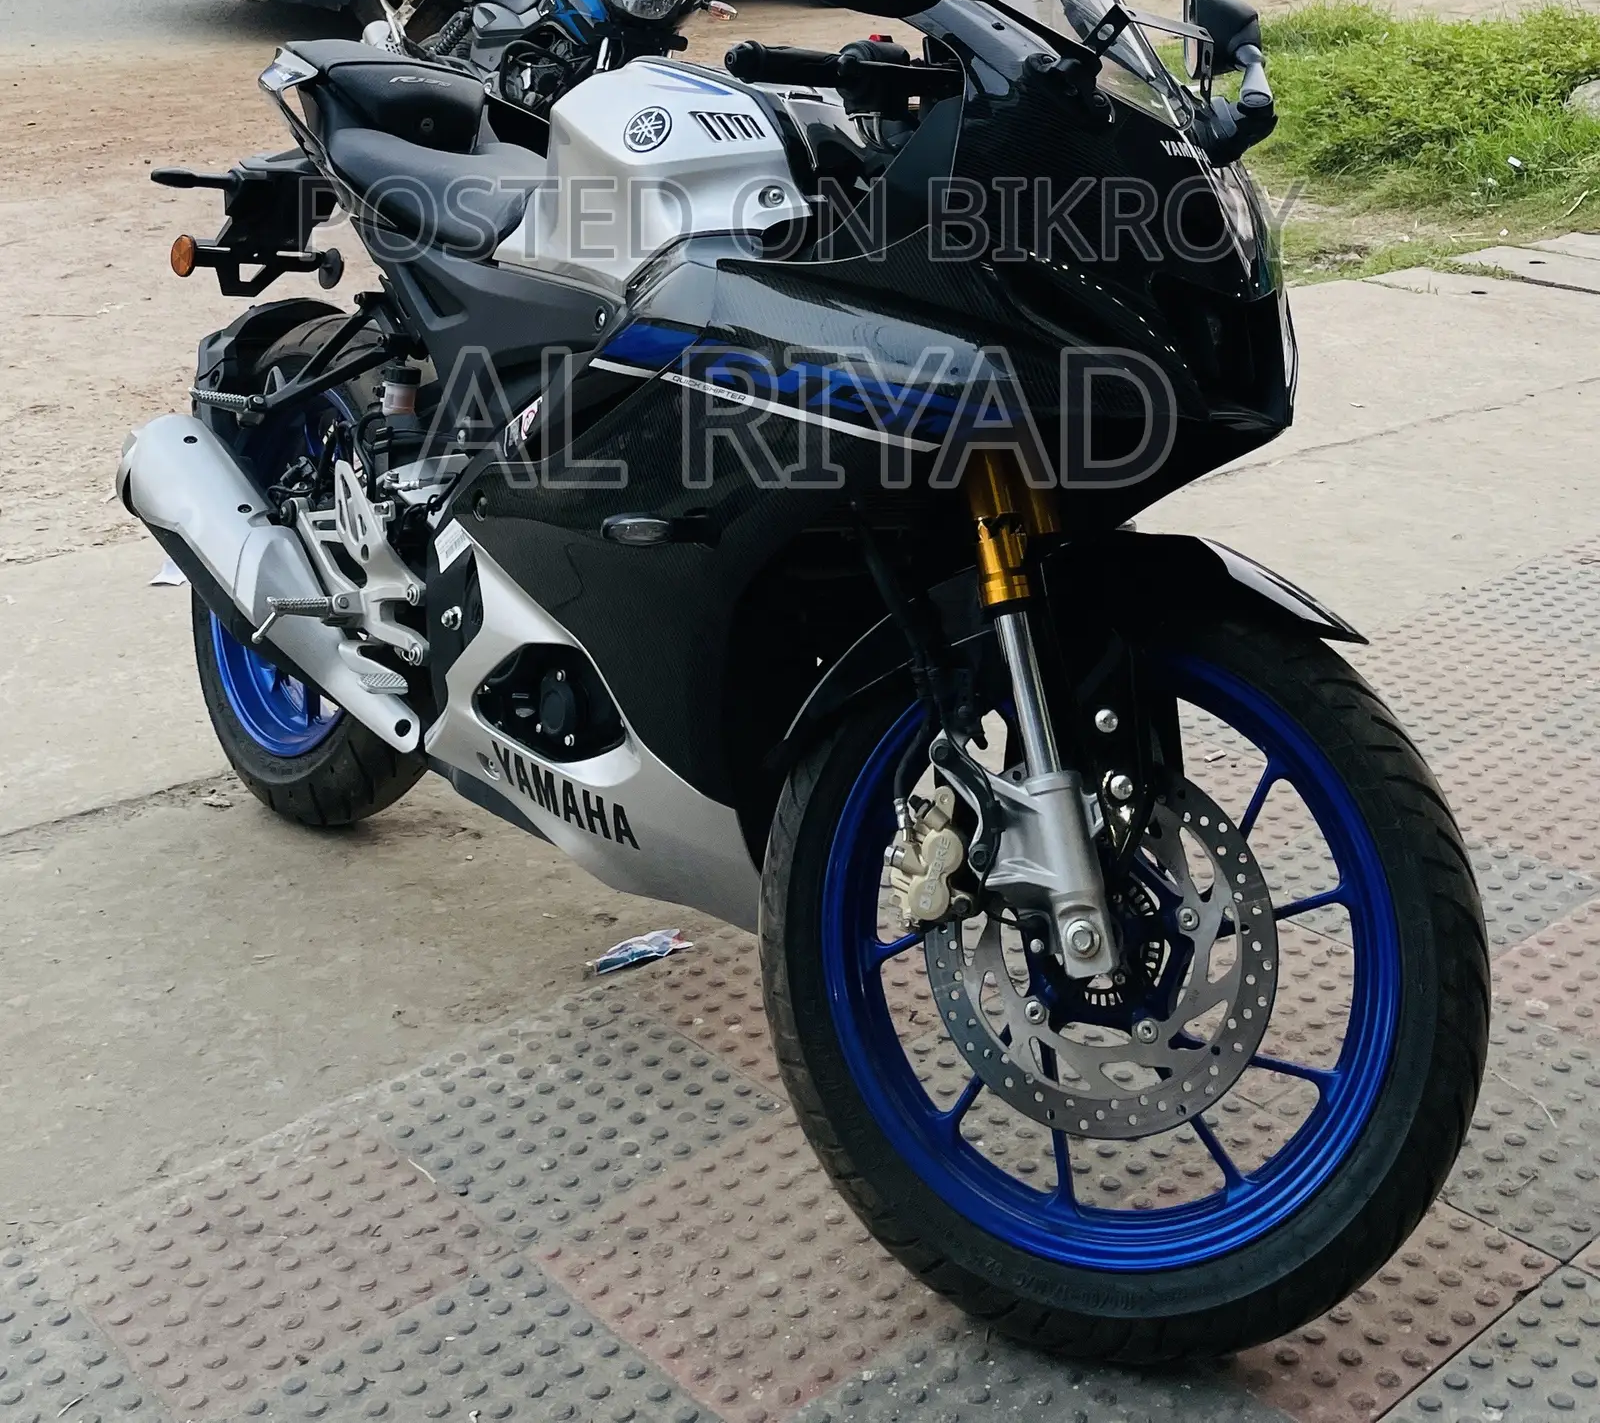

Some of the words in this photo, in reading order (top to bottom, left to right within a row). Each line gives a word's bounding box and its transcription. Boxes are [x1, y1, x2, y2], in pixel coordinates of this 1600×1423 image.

[1159, 139, 1213, 166] YAMHA
[672, 375, 701, 388] QUICK
[702, 384, 747, 402] SHIFTER
[491, 739, 641, 851] YAMAHA
